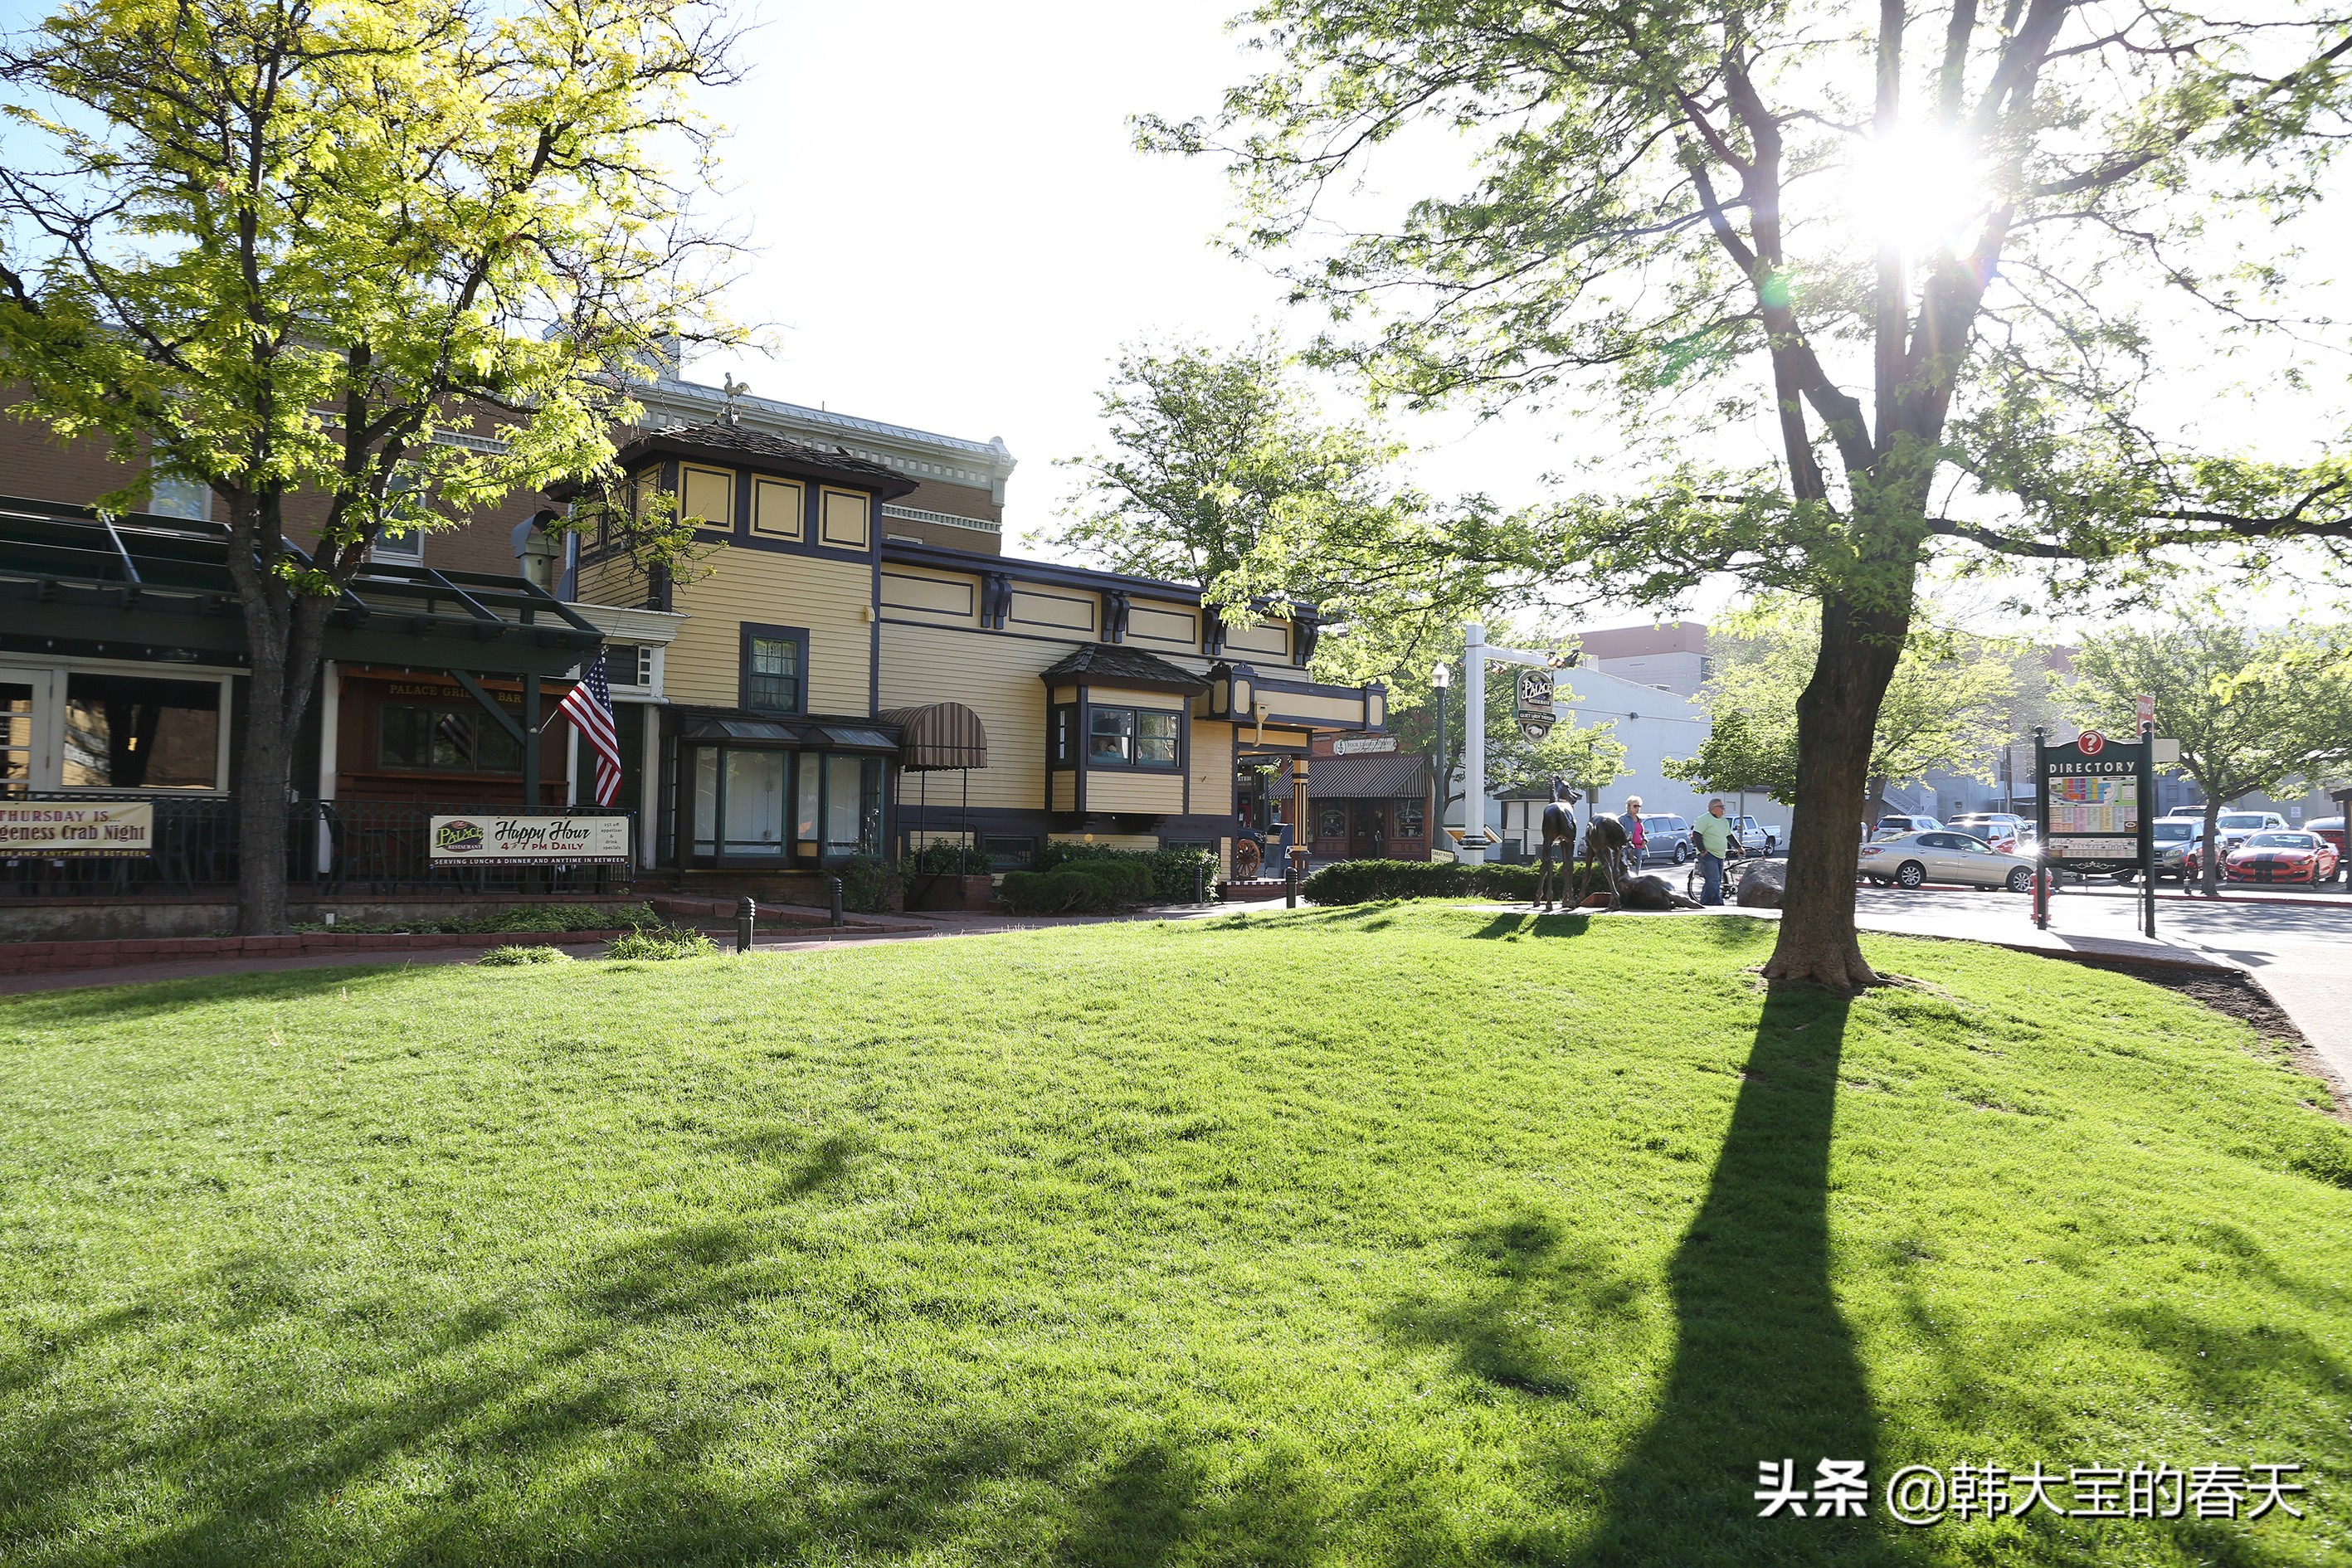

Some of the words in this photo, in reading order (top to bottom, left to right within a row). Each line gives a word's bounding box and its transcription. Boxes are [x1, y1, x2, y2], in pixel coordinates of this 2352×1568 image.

[390, 684, 437, 695] PALACE
[443, 687, 472, 698] GRIL
[498, 693, 521, 704] BAR
[1522, 679, 1552, 699] PALACE
[2085, 733, 2097, 752] ?
[2049, 762, 2135, 773] DIRECTORY
[0, 811, 85, 822] THURSDAY
[62, 825, 97, 840] Crab
[104, 825, 145, 842] Night
[436, 827, 484, 848] PALACE
[495, 820, 546, 845] Happy
[549, 820, 592, 840] Hour
